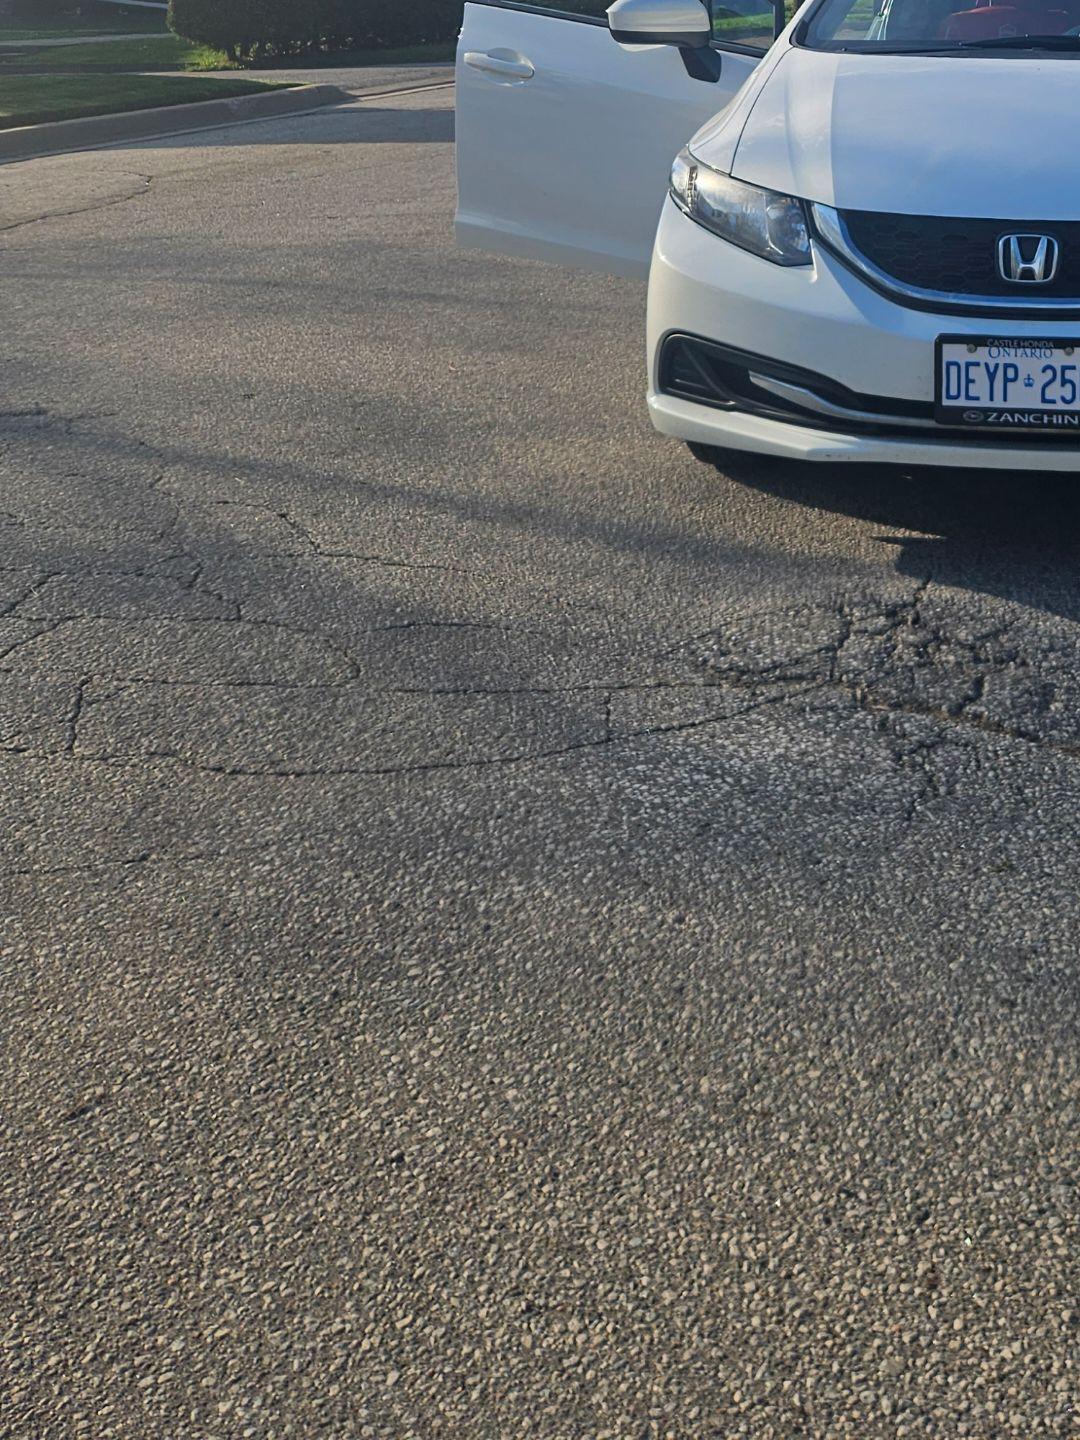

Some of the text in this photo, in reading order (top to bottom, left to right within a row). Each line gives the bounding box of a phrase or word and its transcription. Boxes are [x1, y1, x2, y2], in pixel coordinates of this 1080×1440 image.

[986, 338, 1054, 348] CASTLE HONDA
[988, 346, 1053, 360] ONTARIO
[945, 360, 1019, 402] DEYP
[986, 412, 1079, 425] ZANCHIN
